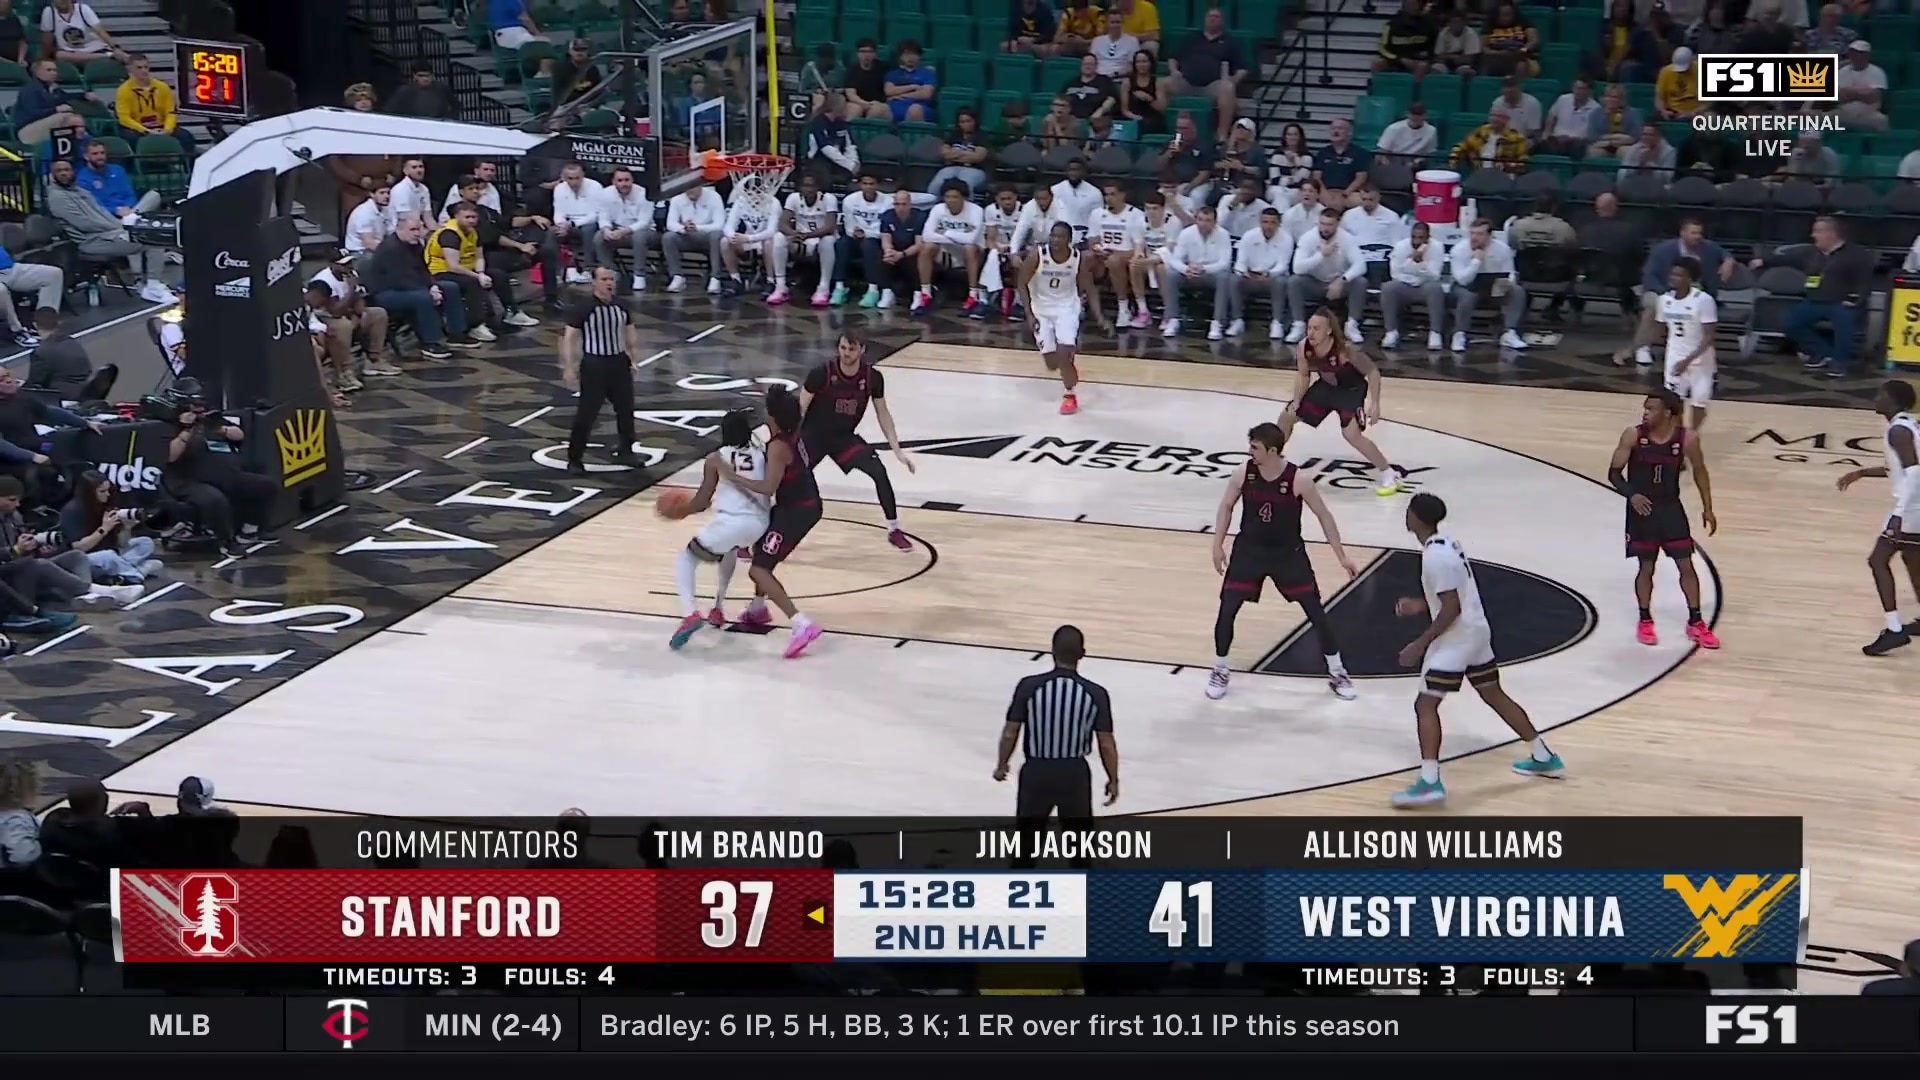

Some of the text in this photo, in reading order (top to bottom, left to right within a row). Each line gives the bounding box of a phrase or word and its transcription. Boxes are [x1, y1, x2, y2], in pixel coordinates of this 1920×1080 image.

[193, 51, 239, 74] 15:28
[195, 74, 231, 100] 21
[791, 102, 807, 119] C
[57, 137, 72, 155] D
[571, 141, 605, 154] MGM
[575, 153, 613, 163] GARDEN
[1103, 230, 1124, 245] 55
[1049, 277, 1061, 289] 0
[272, 306, 305, 340] JSX
[1673, 321, 1685, 338] 3
[1010, 450, 1423, 494] INSURCE
[1653, 464, 1663, 484] 1
[1258, 502, 1273, 523] 4
[0, 600, 365, 748] LAS
